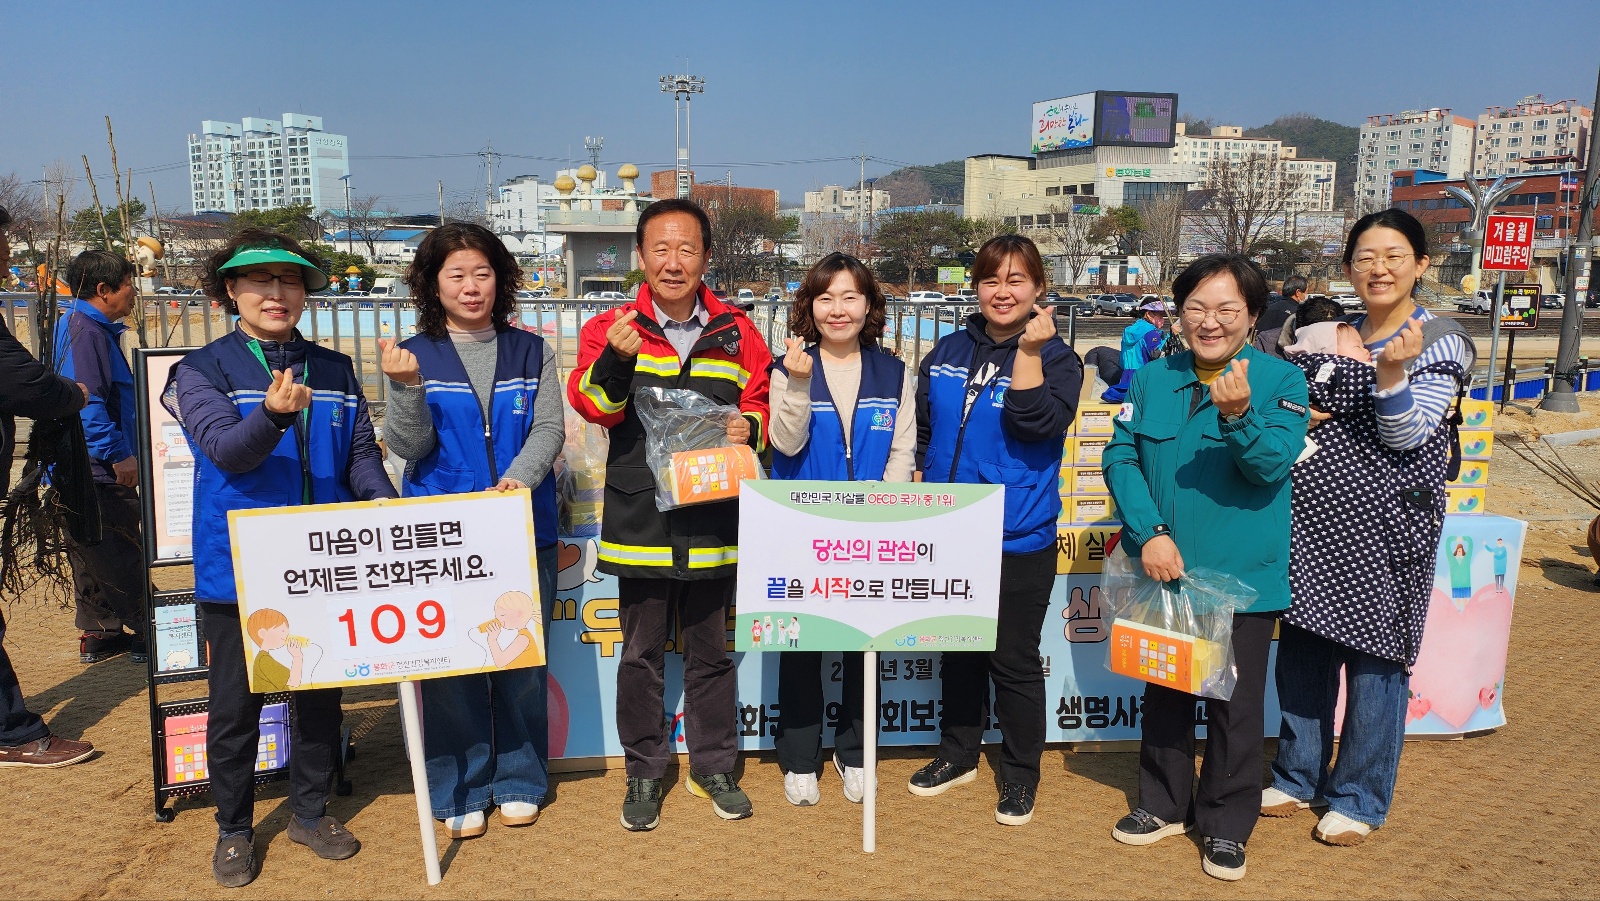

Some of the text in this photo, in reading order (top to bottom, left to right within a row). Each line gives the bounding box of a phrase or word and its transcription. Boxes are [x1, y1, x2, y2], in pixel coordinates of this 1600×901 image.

[1493, 222, 1527, 242] 겨울철
[1485, 245, 1529, 265] 미끄럼주의
[790, 491, 956, 508] 대한민국 자살률 OECD 국가 중 1위!
[308, 520, 464, 556] 마음이 힘들면
[812, 539, 934, 563] 당신의 관심이
[283, 553, 495, 596] 언제든 전화주세요.
[767, 577, 974, 600] 끝을 시작으로 만듭니다.
[338, 599, 446, 647] 109
[373, 661, 395, 671] 봉화군
